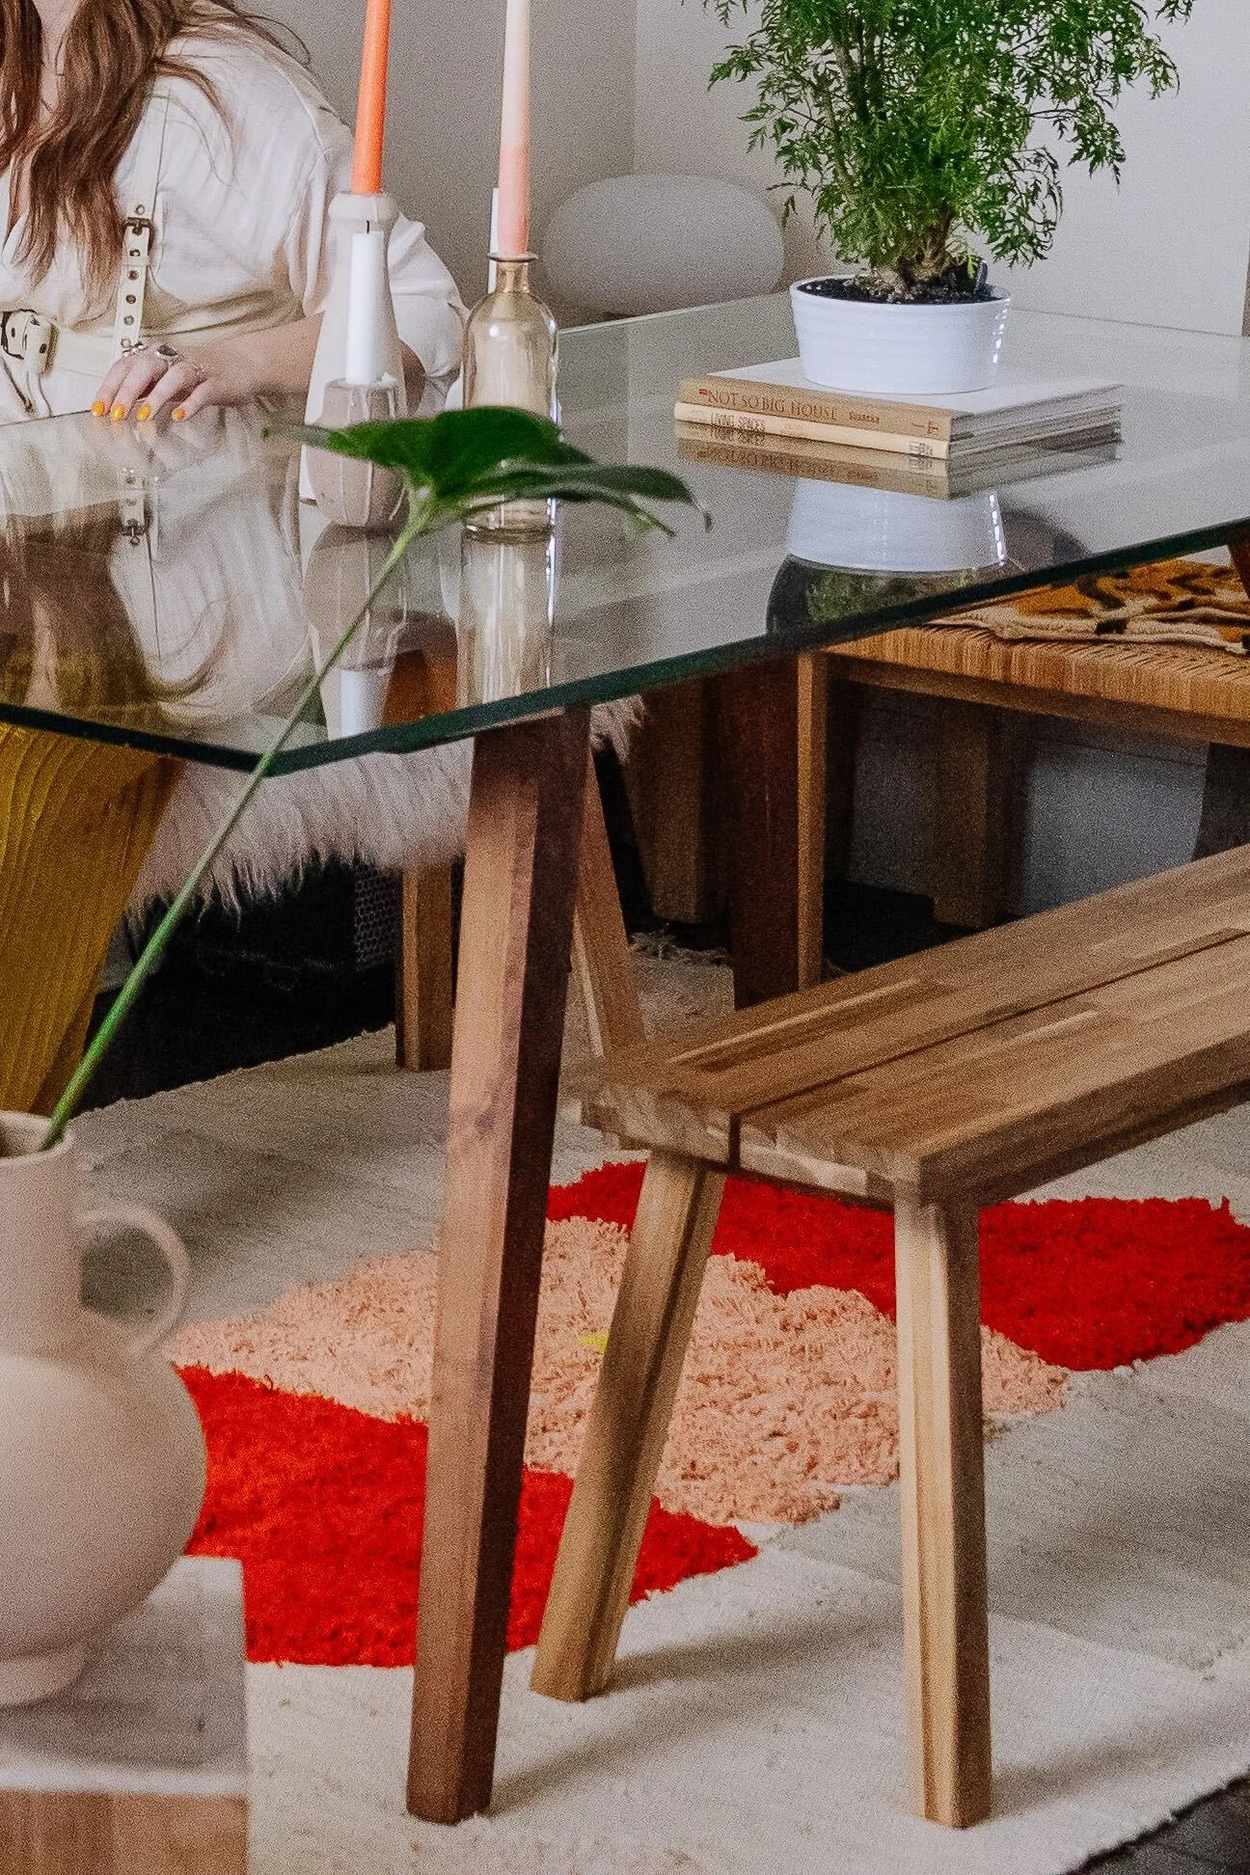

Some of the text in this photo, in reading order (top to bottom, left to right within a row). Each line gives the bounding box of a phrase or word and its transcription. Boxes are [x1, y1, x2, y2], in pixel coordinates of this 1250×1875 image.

[708, 390, 739, 406] NOT
[741, 395, 760, 410] SO
[761, 396, 786, 414] BIG
[790, 400, 838, 421] HOUSE
